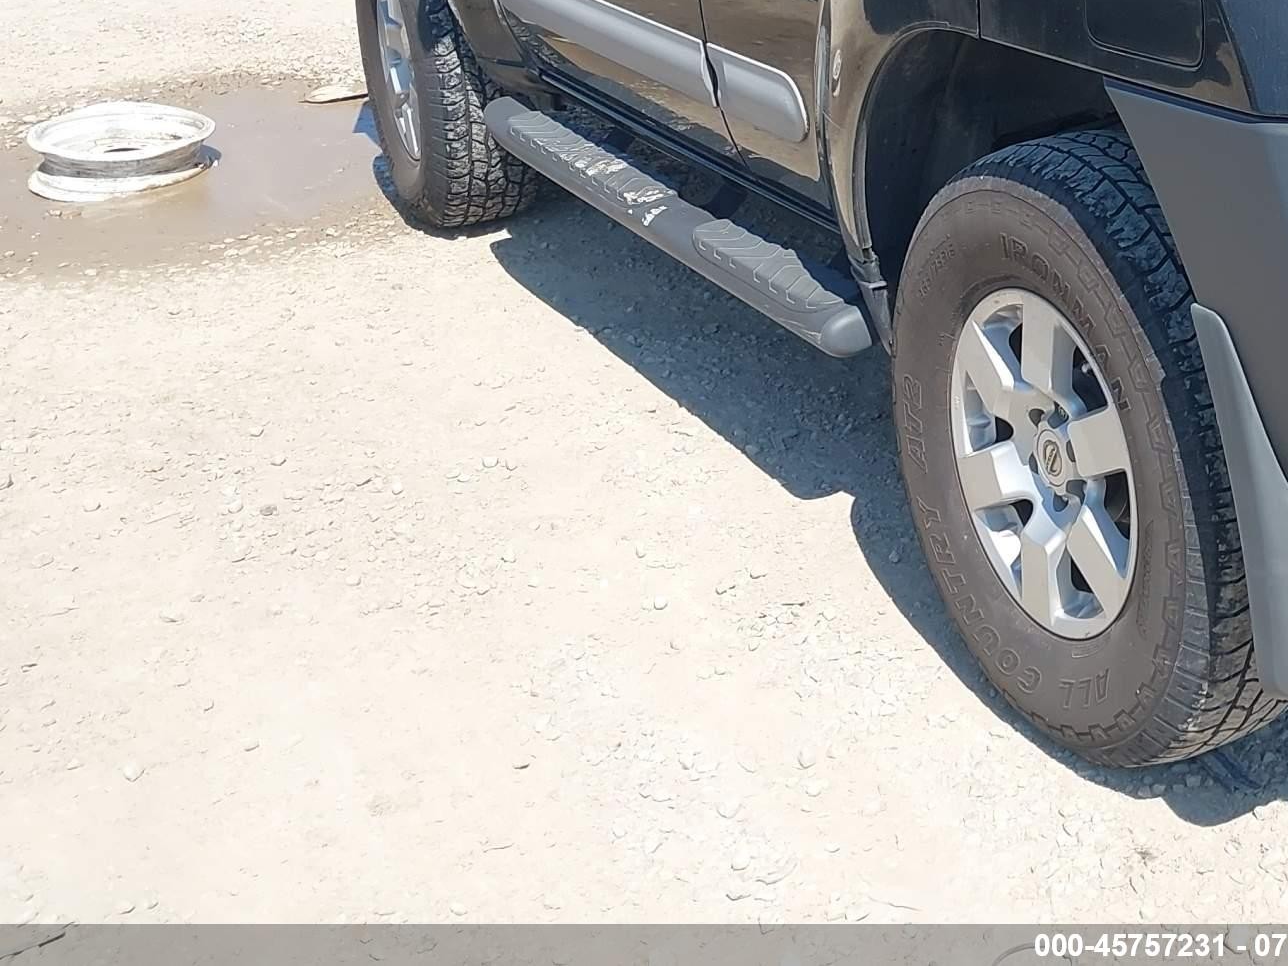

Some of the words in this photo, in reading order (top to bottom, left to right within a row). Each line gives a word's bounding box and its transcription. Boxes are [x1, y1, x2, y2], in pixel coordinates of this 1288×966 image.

[1000, 232, 1131, 411] IRONMAN
[916, 496, 1042, 694] COUNTRY
[1059, 667, 1111, 709] ALL
